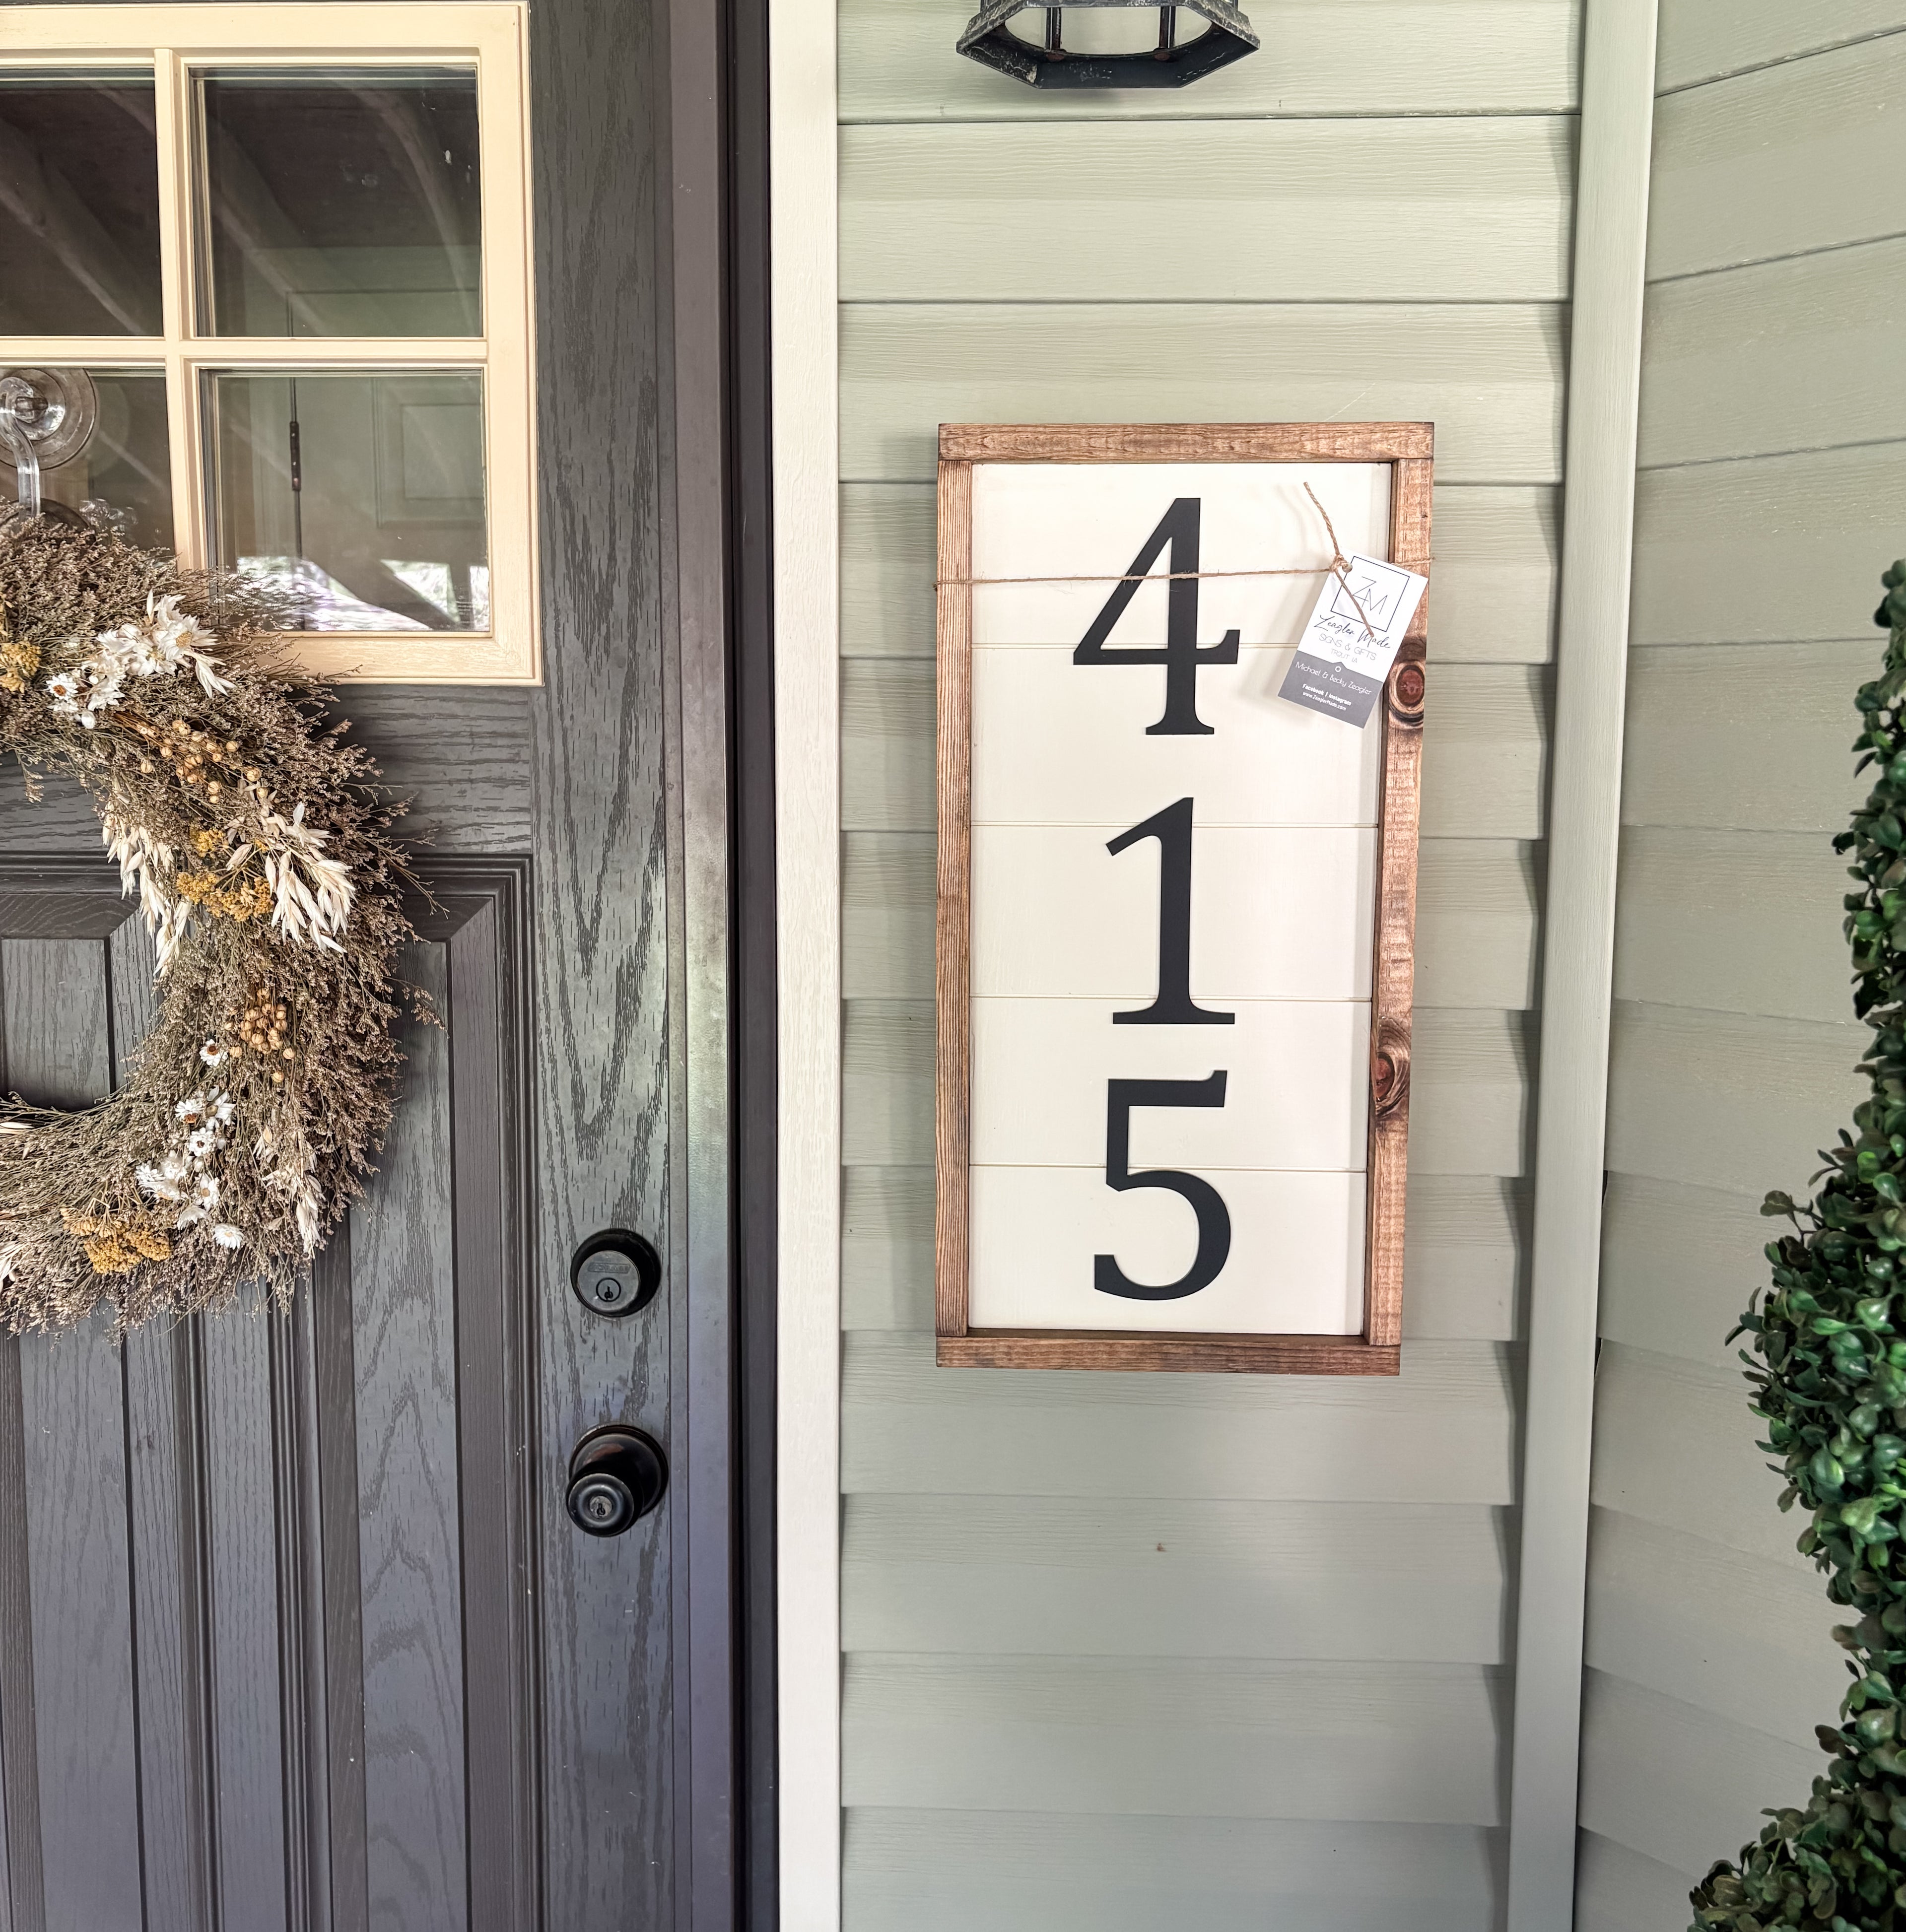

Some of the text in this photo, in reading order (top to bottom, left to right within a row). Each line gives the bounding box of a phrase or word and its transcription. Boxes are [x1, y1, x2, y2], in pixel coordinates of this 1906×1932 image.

[1314, 615, 1390, 648] Zeagler Made
[1319, 633, 1343, 647] SGNS
[1354, 647, 1377, 660] GFTS
[1295, 661, 1321, 676] Michael
[1330, 674, 1347, 687] Becky
[1348, 681, 1372, 694] Zeagler
[1302, 683, 1324, 696] Facebook
[1329, 693, 1352, 706] Instagram
